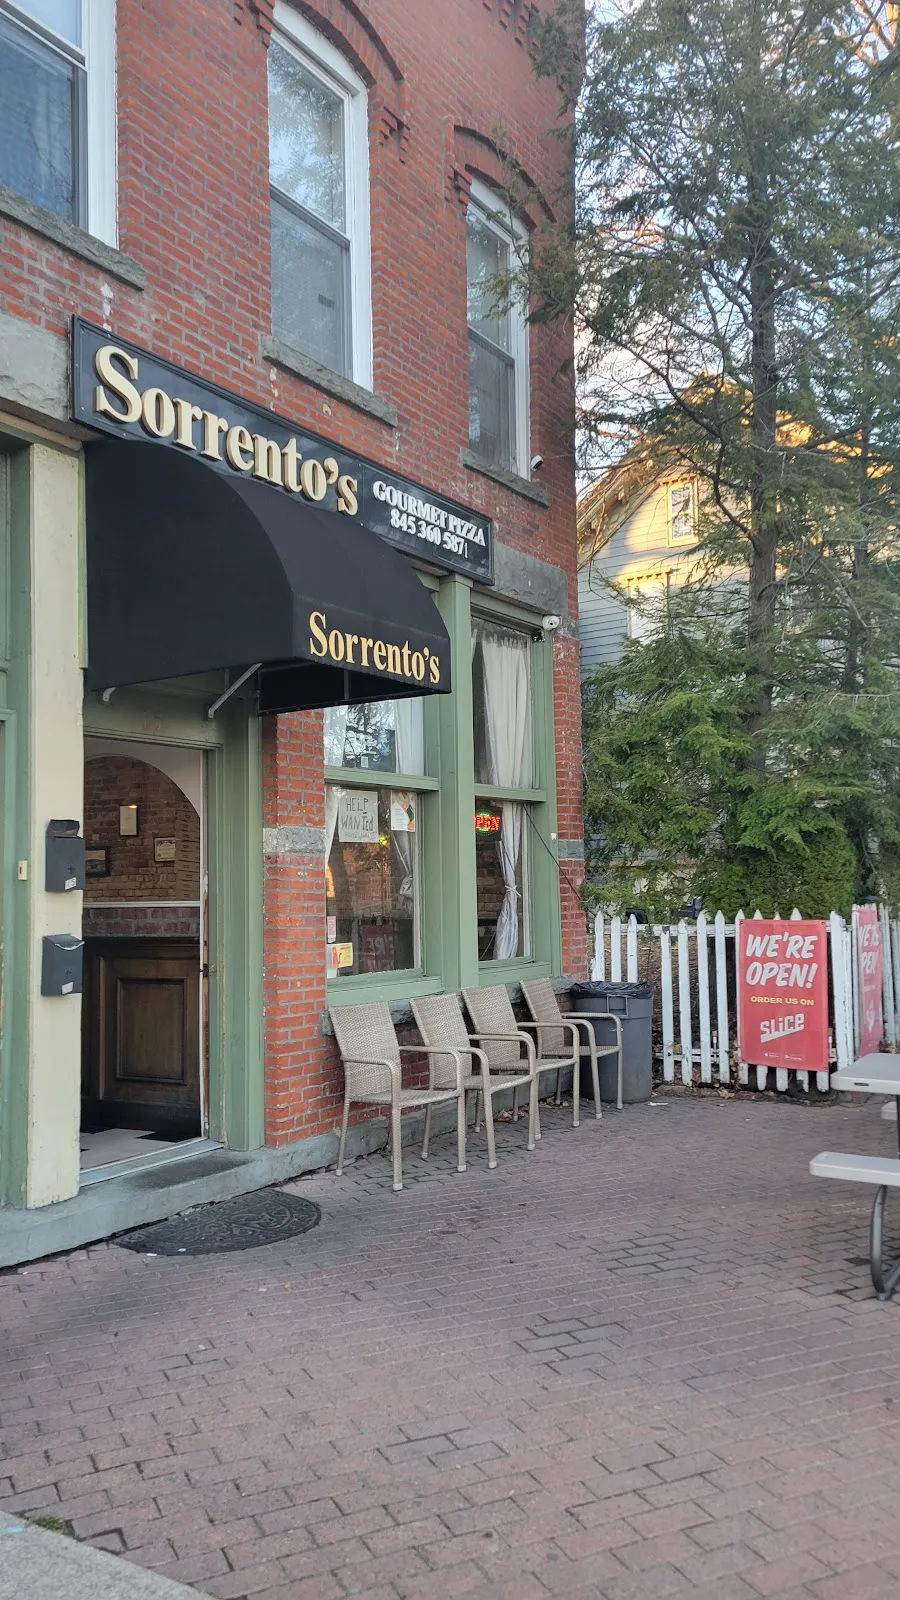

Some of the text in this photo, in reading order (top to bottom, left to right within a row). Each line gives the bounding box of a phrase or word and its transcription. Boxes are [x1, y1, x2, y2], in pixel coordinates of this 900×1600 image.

[95, 344, 359, 517] Sorrento's
[372, 480, 486, 547] GOURMET PIZZA
[390, 508, 468, 559] 845 360 5871
[308, 610, 442, 685] Sorrento's
[346, 797, 369, 812] HELP
[474, 814, 501, 832] PEN
[745, 931, 819, 959] WE'RE
[745, 962, 819, 989] OPEN!
[750, 996, 815, 1006] ORDER US ON
